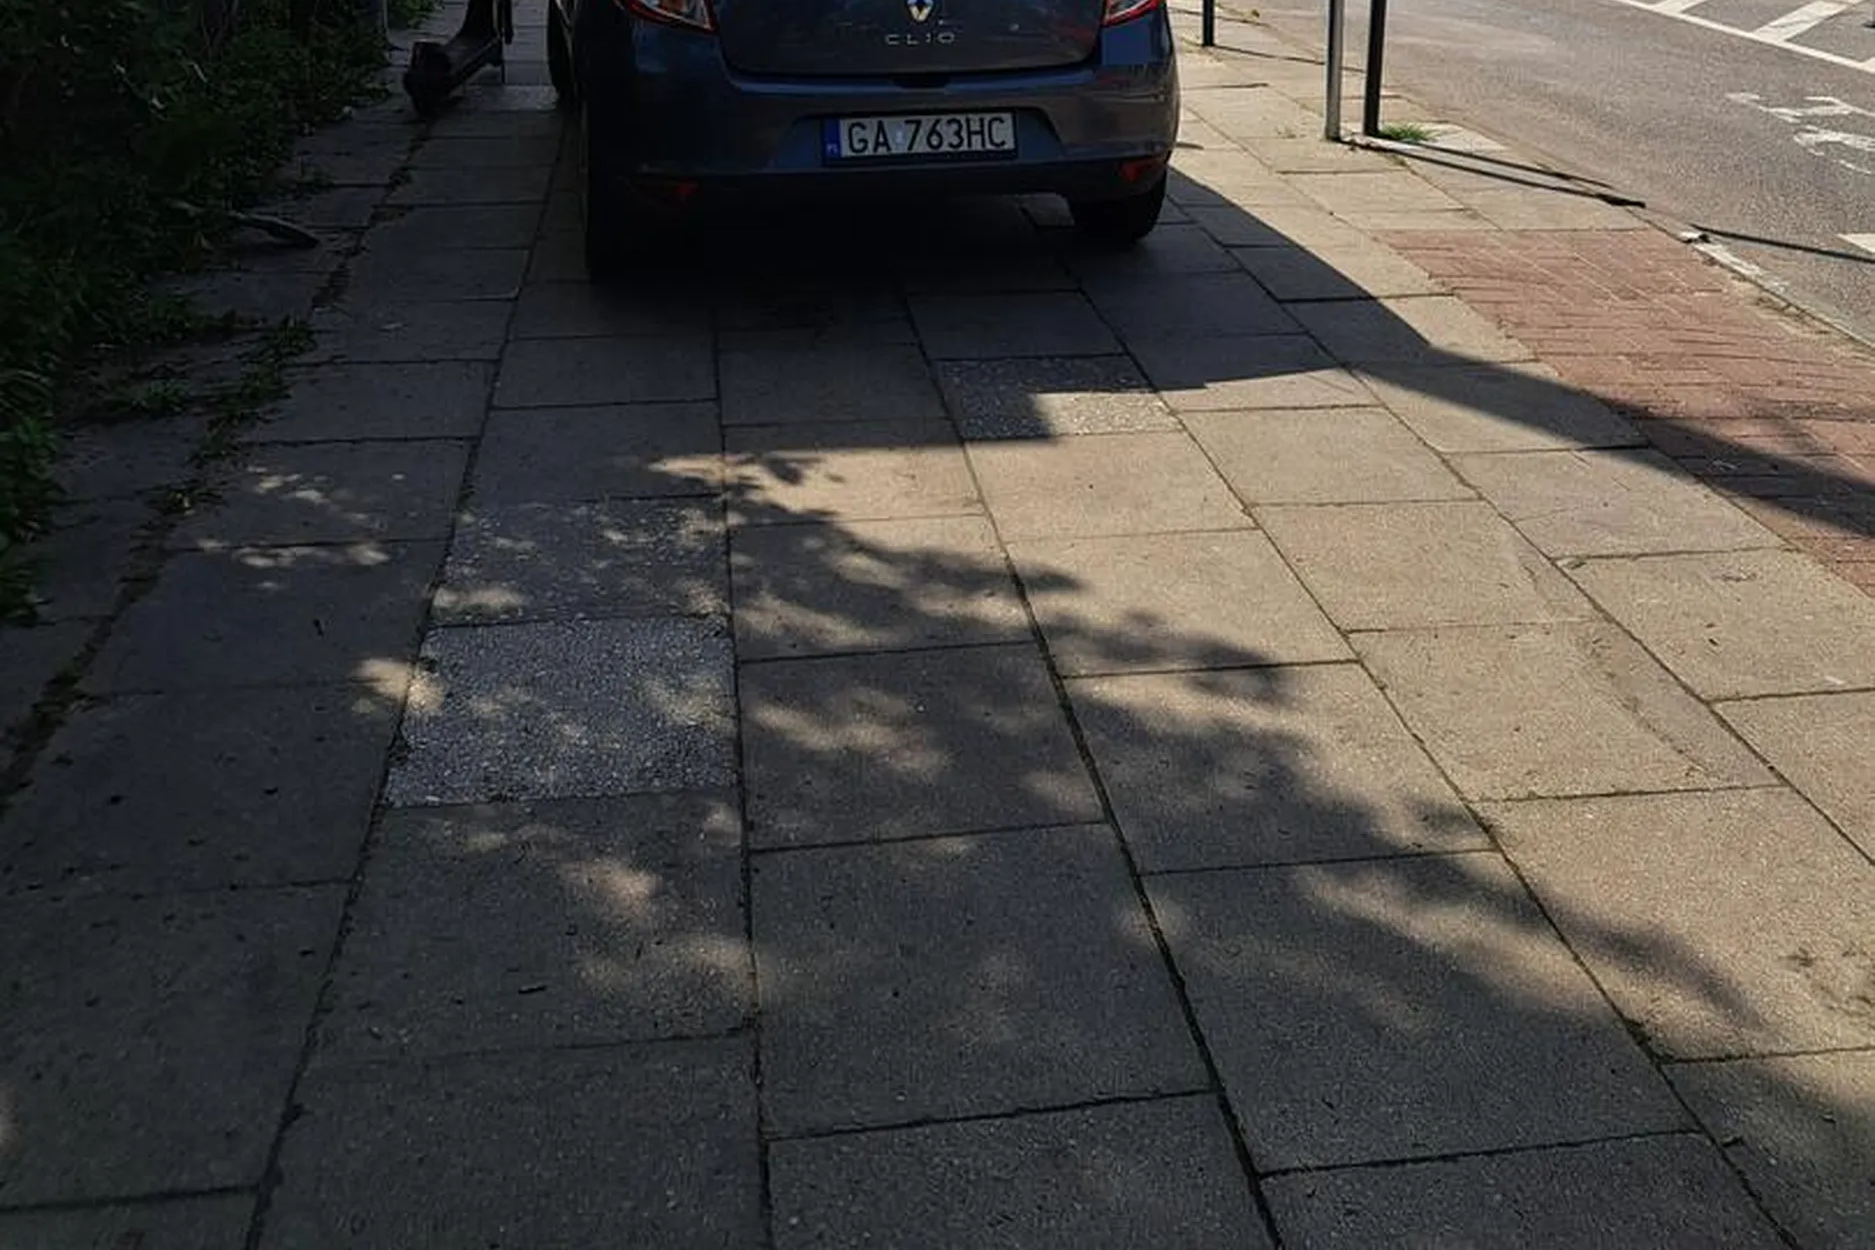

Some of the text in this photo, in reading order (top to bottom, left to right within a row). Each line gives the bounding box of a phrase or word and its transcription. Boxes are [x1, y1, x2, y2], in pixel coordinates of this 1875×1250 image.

[886, 33, 955, 44] CLIO
[847, 117, 1005, 154] GA 763HC
